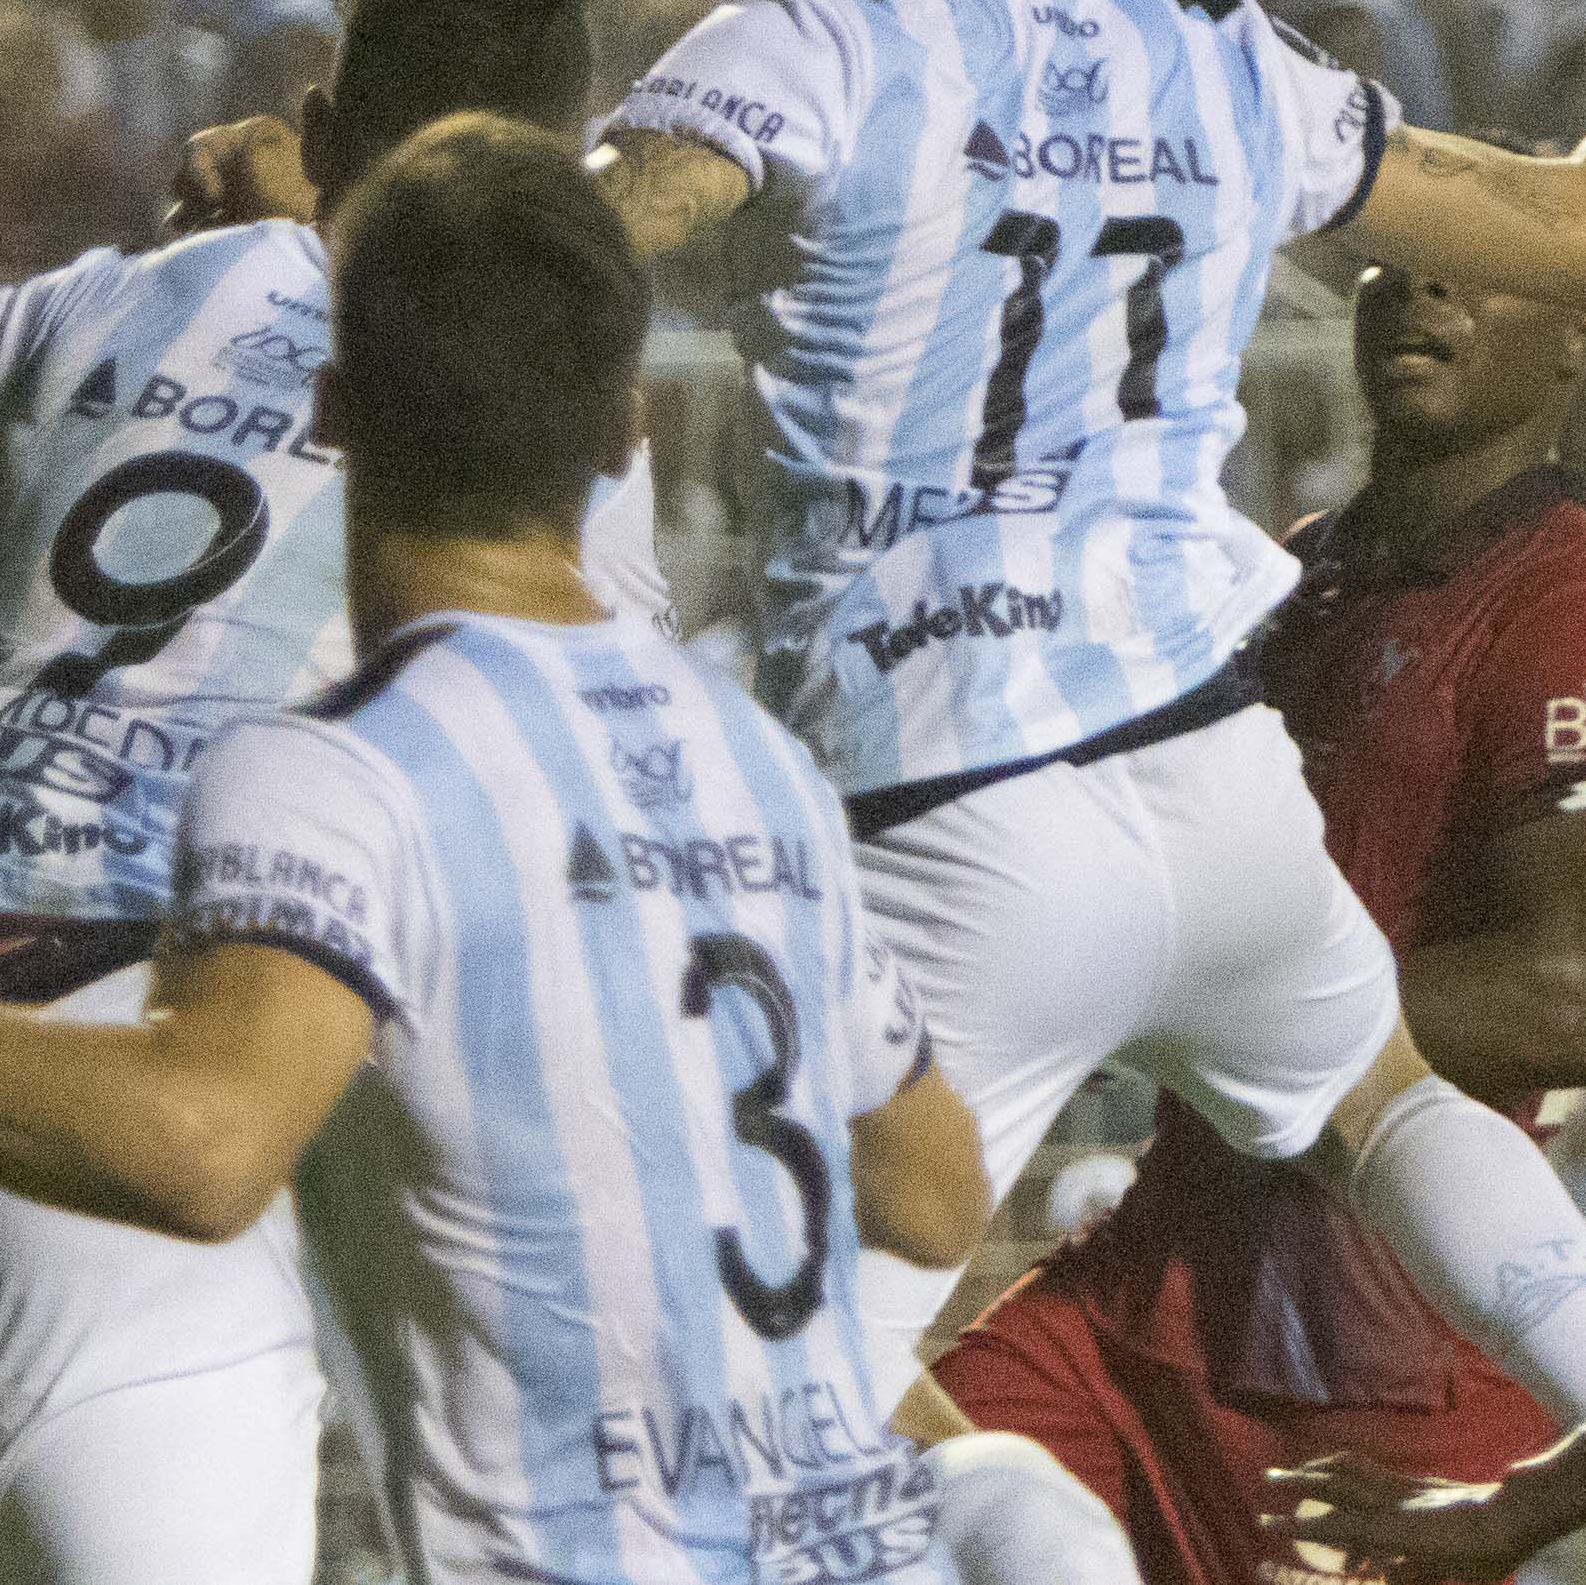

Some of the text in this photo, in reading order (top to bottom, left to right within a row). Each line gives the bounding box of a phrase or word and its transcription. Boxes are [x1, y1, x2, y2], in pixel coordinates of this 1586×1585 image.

[1014, 130, 1220, 187] BOREAL
[32, 450, 270, 700] 9
[681, 932, 831, 1342] 3
